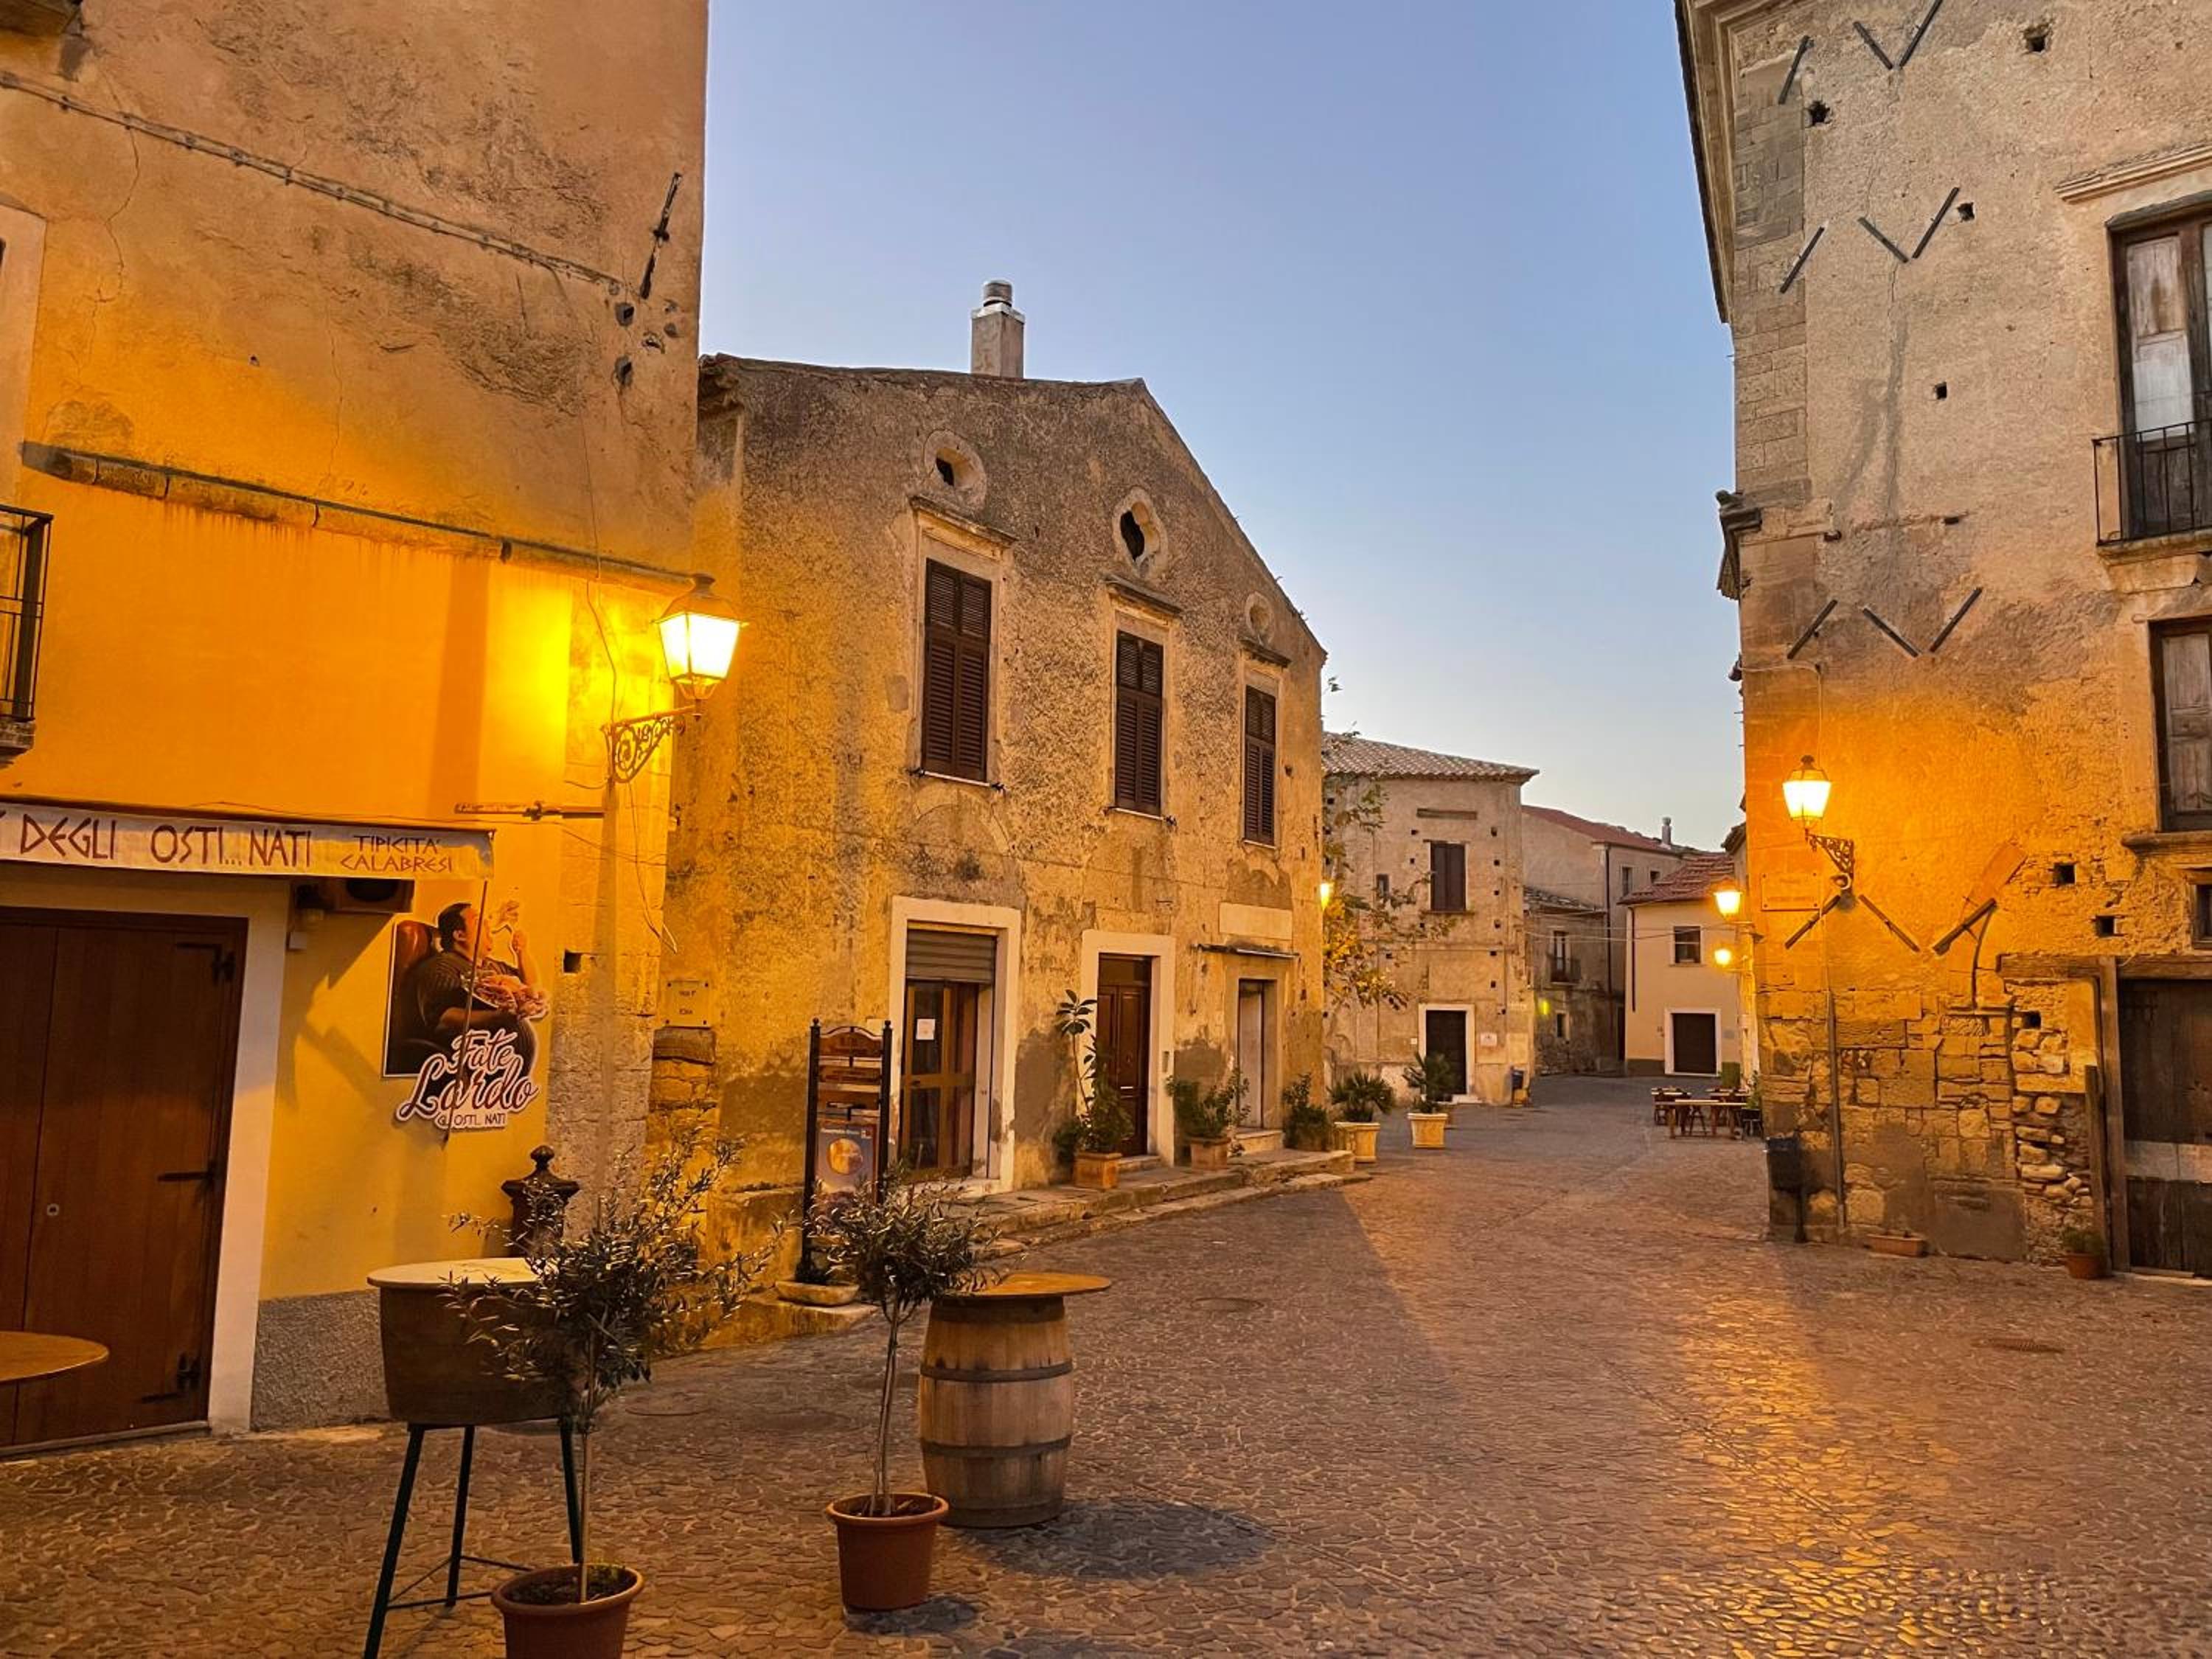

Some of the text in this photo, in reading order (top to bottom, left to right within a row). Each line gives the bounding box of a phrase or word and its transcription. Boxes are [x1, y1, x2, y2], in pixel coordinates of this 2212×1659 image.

[21, 813, 116, 860] DEGLI
[248, 828, 311, 867] NATI
[340, 855, 452, 873] CALABRESI
[448, 1029, 518, 1074] Fate
[397, 1054, 538, 1119] Lardo
